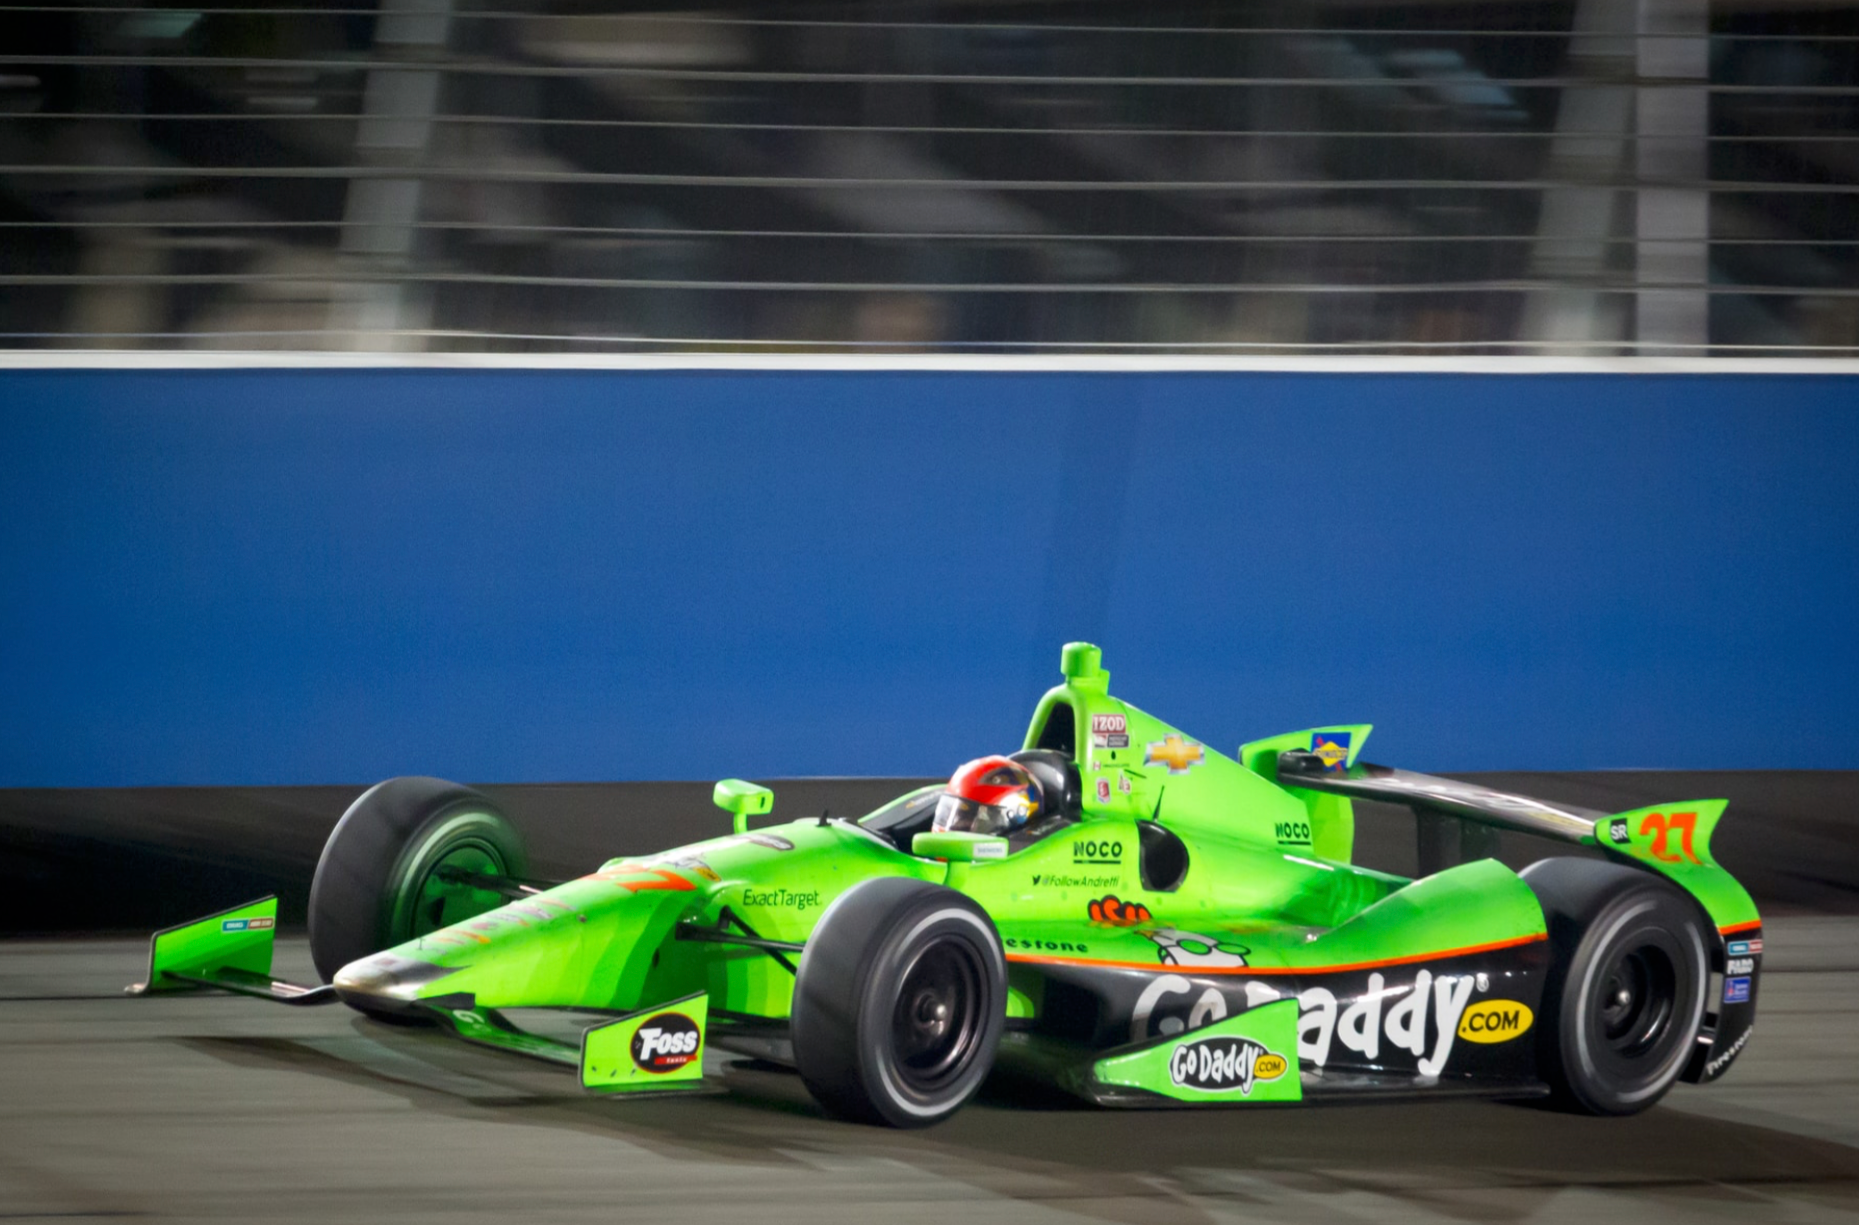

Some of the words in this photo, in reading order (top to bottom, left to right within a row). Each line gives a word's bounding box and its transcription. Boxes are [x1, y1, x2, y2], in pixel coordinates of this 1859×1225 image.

[1094, 715, 1126, 732] IZOD
[1275, 822, 1310, 839] NOCO
[1610, 823, 1628, 840] SR
[1638, 811, 1702, 865] 27
[1073, 841, 1123, 858] NOCO
[743, 888, 820, 910] ExactTarget
[1004, 937, 1089, 954] estone
[1461, 1010, 1521, 1033] .COM
